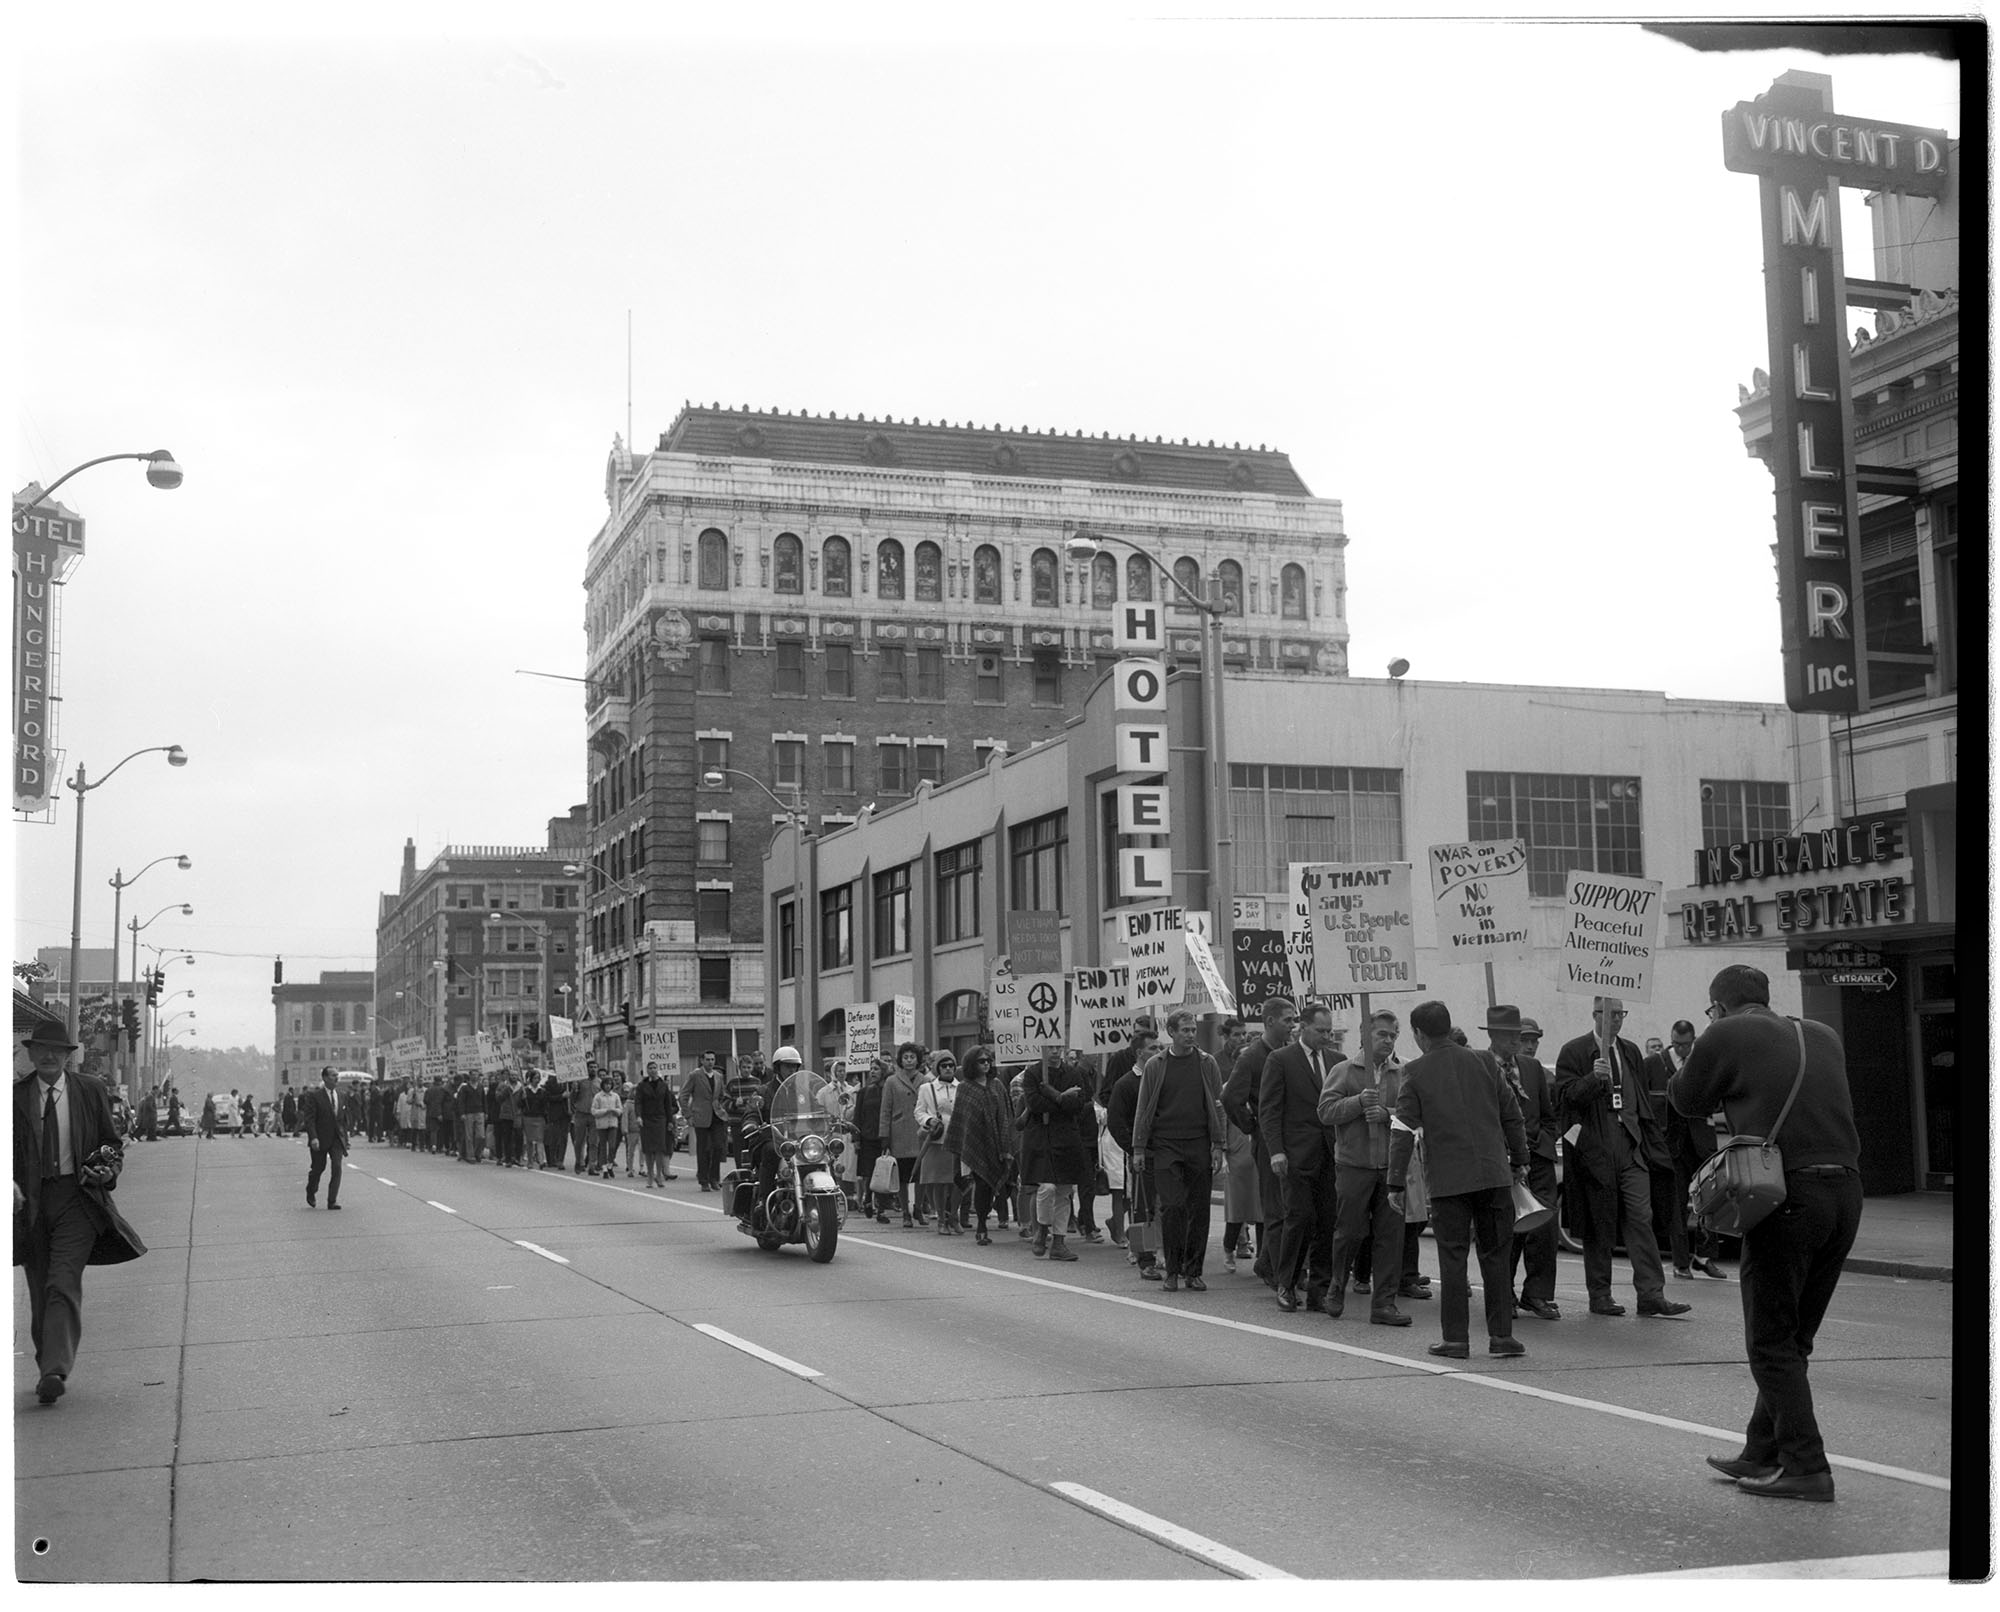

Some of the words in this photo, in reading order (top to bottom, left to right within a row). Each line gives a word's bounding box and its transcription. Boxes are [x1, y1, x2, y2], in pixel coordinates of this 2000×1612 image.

[1743, 112, 1900, 169] VINCENT
[1780, 182, 1851, 639] MILLER
[21, 551, 47, 786] HUNGERFORD
[1807, 664, 1855, 695] Inc.
[1126, 608, 1163, 888] HOTEL
[1434, 846, 1472, 862] WAR
[1477, 846, 1495, 857] on
[1695, 821, 1887, 885] INSURANCE
[1440, 846, 1526, 885] POVERTY
[1328, 869, 1391, 889] THANT
[1465, 883, 1488, 901] NO
[1569, 882, 1656, 916] SUPPORT
[1318, 894, 1363, 912] says
[1460, 903, 1495, 917] War
[1681, 896, 1763, 940] REAL
[1776, 877, 1903, 931] ESTATE
[1128, 912, 1151, 937] END
[1153, 908, 1183, 931] THE
[1246, 911, 1260, 919] DAY
[1324, 914, 1356, 930] U.S.
[1360, 910, 1410, 931] People
[1479, 918, 1496, 930] in
[1574, 912, 1643, 937] Peaceful
[1345, 928, 1375, 943] not
[1452, 929, 1528, 947] Vietnam!
[1565, 931, 1649, 958] Alternatives
[1131, 944, 1150, 957] WAR
[1152, 941, 1165, 955] IN
[1347, 945, 1392, 963] TOLD
[1077, 969, 1107, 990] END
[1109, 968, 1129, 987] TH
[1136, 966, 1169, 980] VIETNAM
[1348, 961, 1408, 982] TRUTH
[1568, 963, 1642, 989] Vietnam!
[1832, 974, 1883, 983] ENTRANCE
[1137, 977, 1176, 999] NOW
[1242, 979, 1256, 995] to
[1080, 997, 1108, 1009] WAR
[1112, 995, 1126, 1008] IN
[848, 1011, 875, 1023] Defense
[1090, 1017, 1132, 1029] VIETNAM
[849, 1024, 877, 1039] Spending
[1023, 1015, 1061, 1039] PAX
[643, 1032, 676, 1045] PEACE
[851, 1040, 878, 1052] Destroys
[649, 1052, 671, 1060] ONLY
